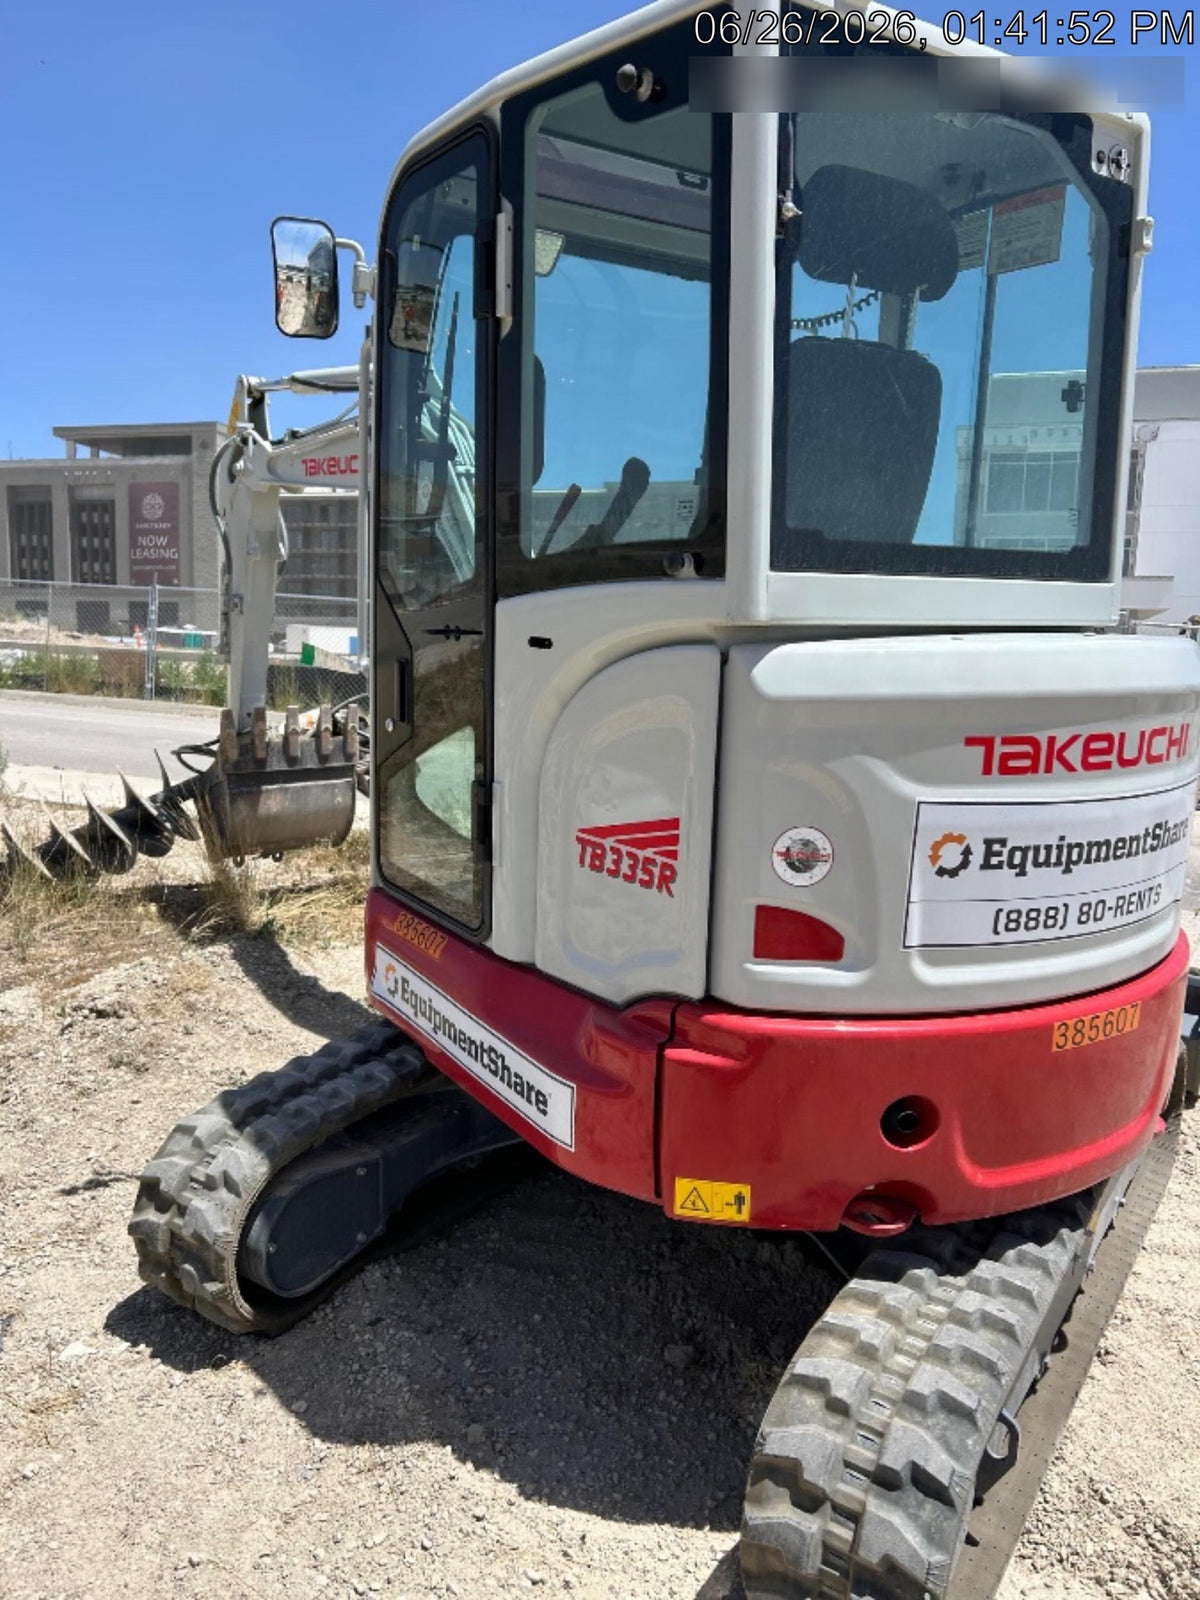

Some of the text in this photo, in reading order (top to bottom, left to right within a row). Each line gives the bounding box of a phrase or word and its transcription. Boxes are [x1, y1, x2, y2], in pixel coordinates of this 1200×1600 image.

[301, 454, 359, 477] TAKEUC
[131, 547, 178, 559] LEASING
[138, 534, 168, 547] NOW
[964, 723, 1190, 776] TAKEUCHI
[575, 834, 678, 898] TB335R
[979, 817, 1189, 878] EquipmentShar
[398, 911, 447, 955] 385607
[992, 883, 1162, 936] (888) 80-RENTS
[400, 975, 550, 1117] EquipmentShare
[1055, 1002, 1139, 1050] 385607
